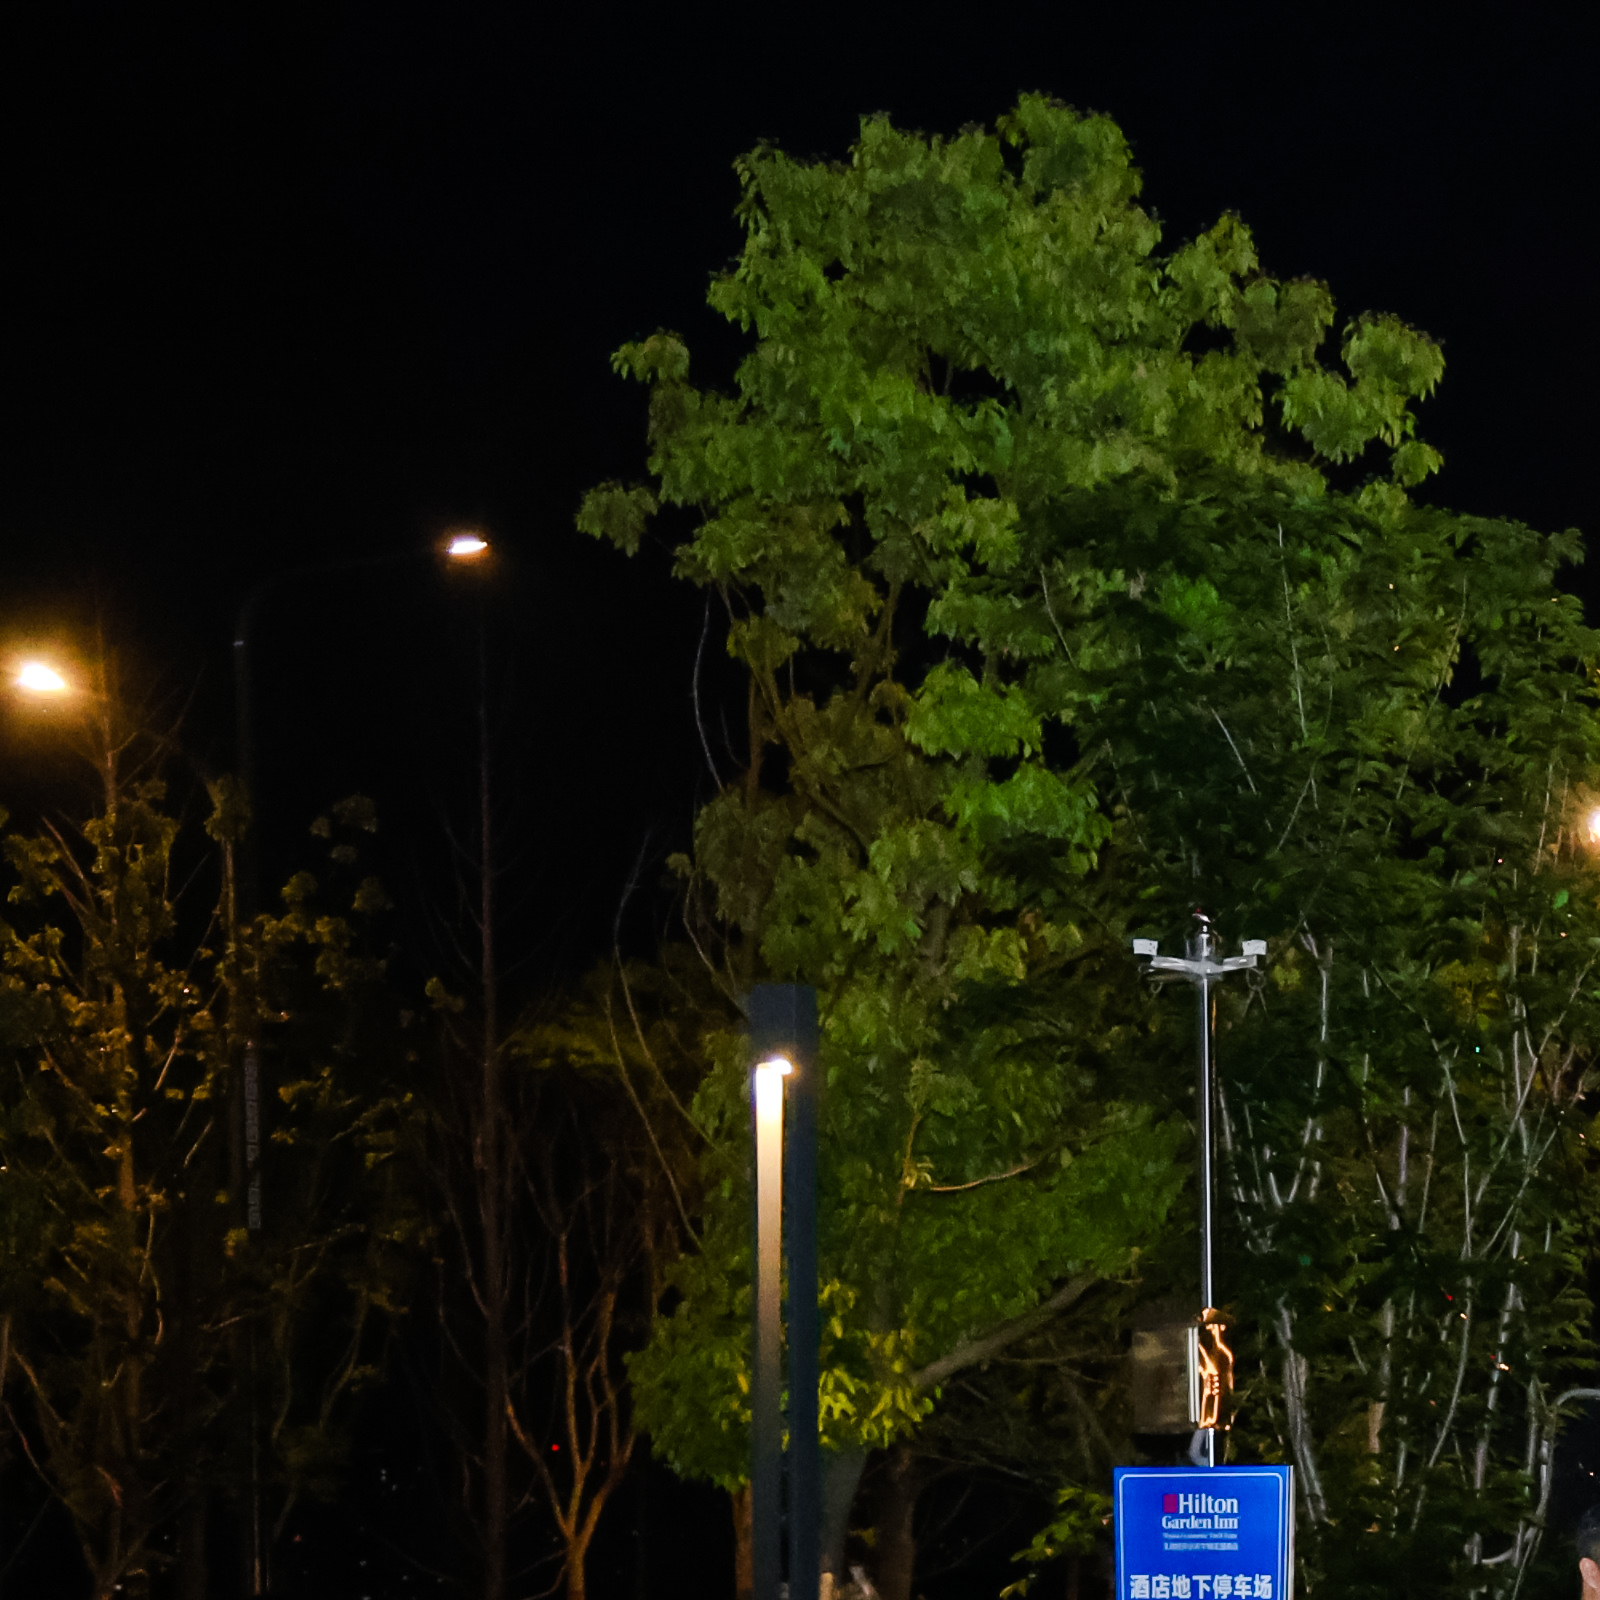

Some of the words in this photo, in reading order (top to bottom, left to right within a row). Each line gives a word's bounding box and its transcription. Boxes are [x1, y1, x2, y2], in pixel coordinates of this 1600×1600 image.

[1178, 1493, 1239, 1514] Hilton
[1161, 1514, 1212, 1529] Garden
[1213, 1514, 1239, 1529] Inn
[1129, 1574, 1272, 1600] 酒店地下停车场
